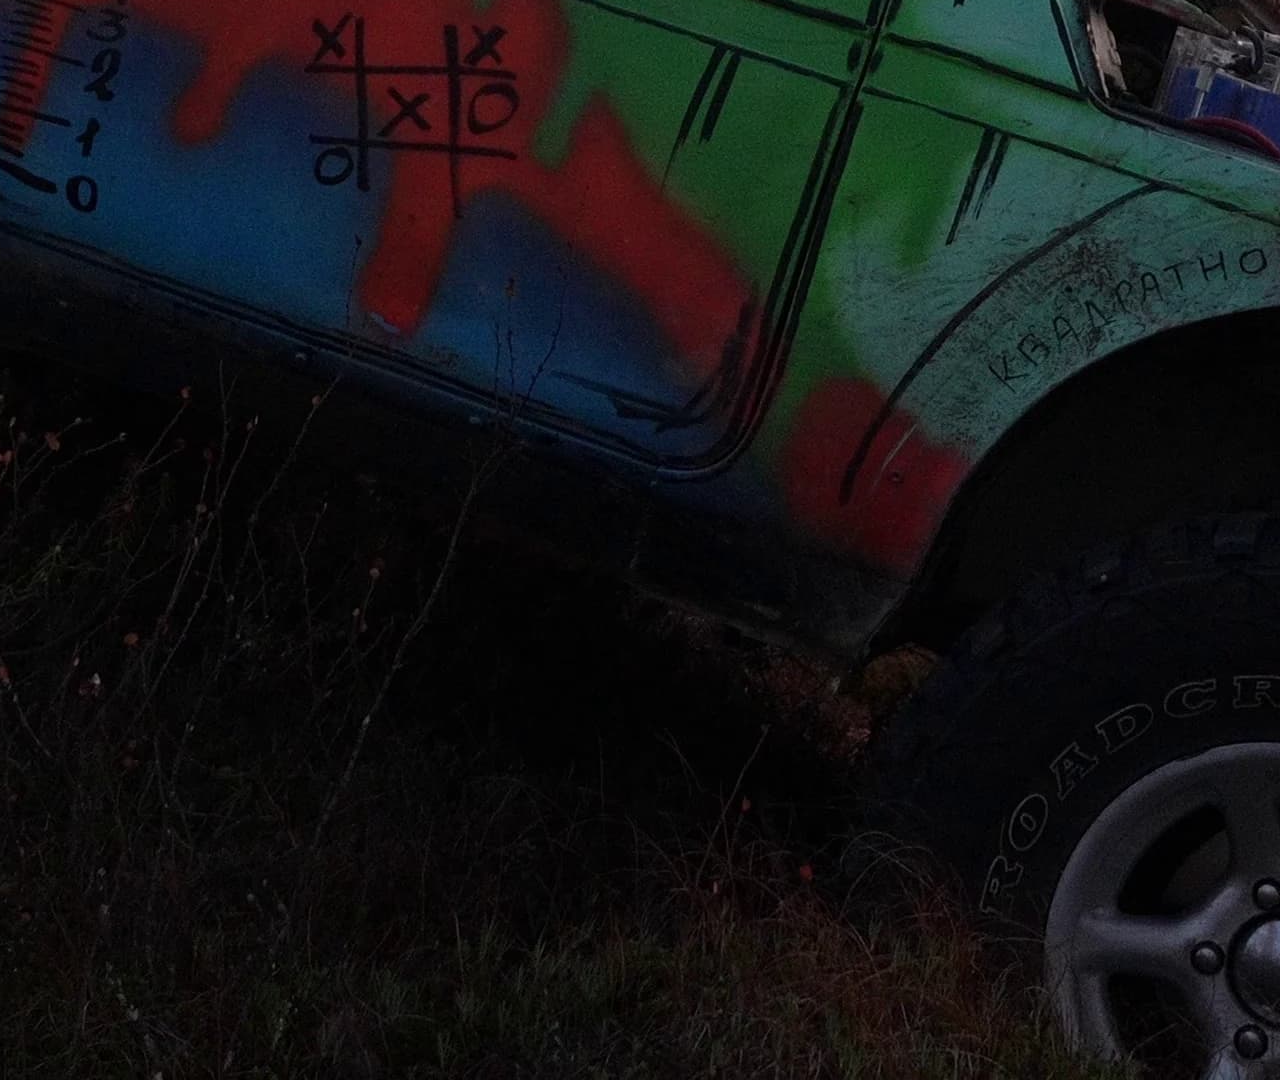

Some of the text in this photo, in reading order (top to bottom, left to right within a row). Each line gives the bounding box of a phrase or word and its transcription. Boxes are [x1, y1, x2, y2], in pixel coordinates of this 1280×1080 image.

[85, 7, 128, 43] 3
[83, 48, 122, 102] 2
[74, 117, 101, 158] 1
[65, 174, 99, 213] 0
